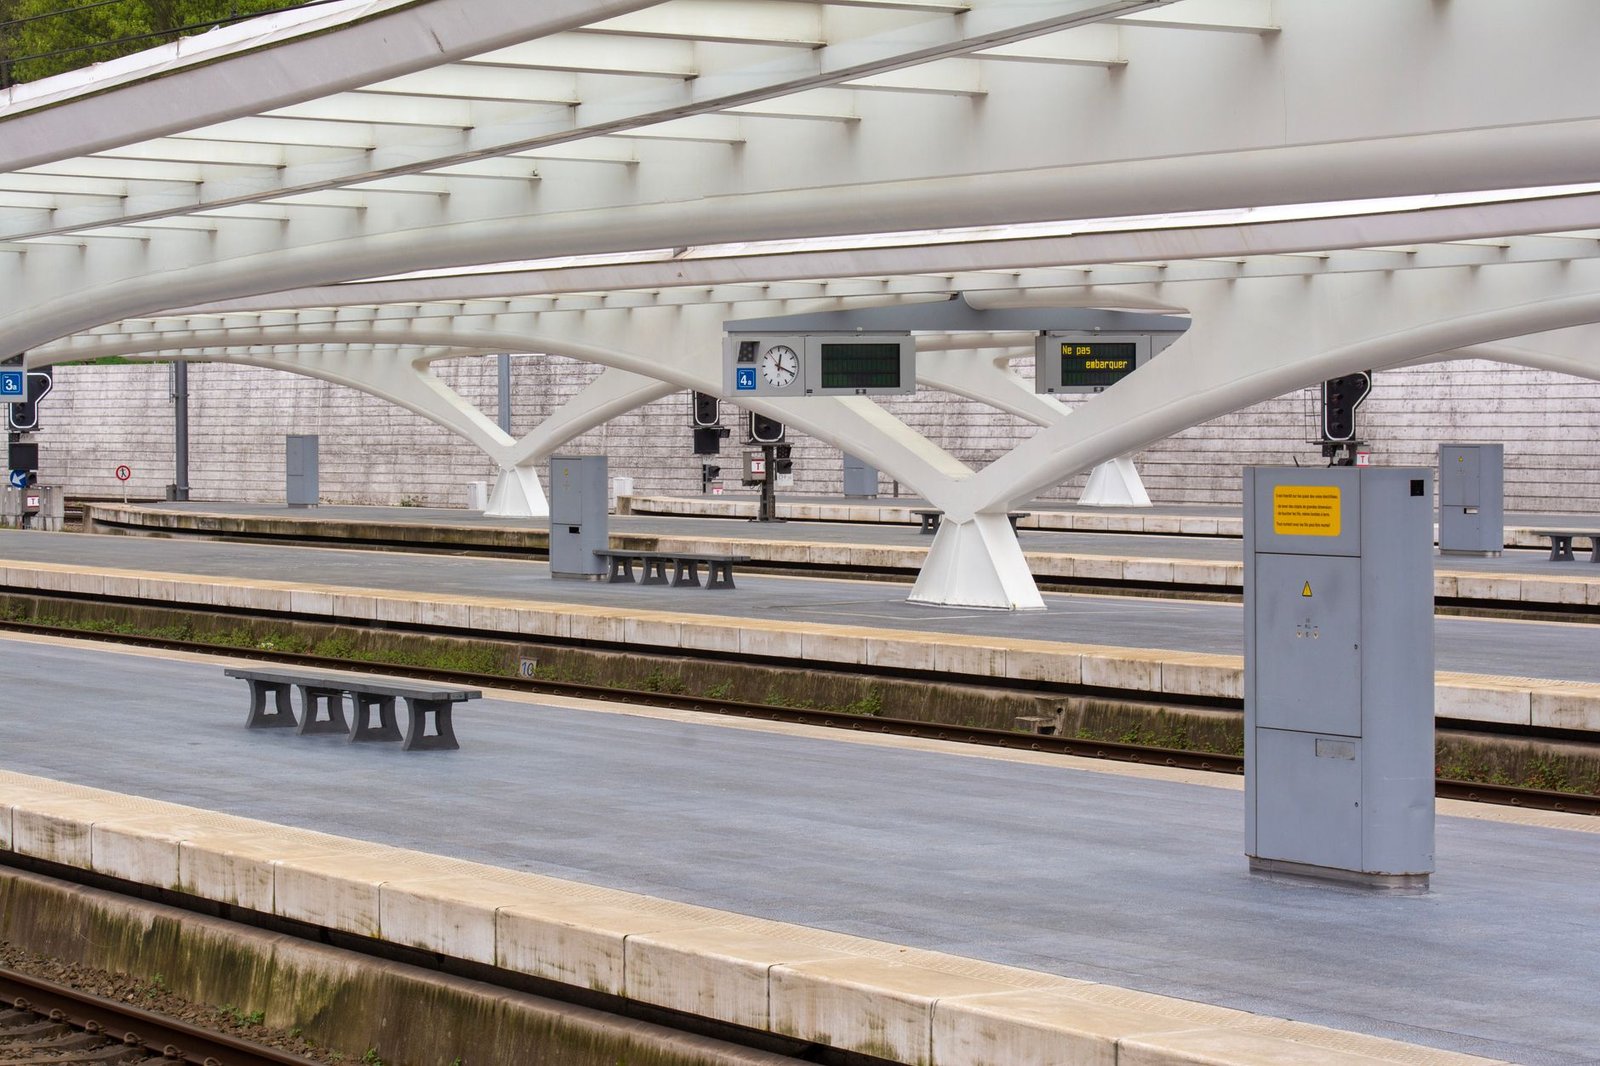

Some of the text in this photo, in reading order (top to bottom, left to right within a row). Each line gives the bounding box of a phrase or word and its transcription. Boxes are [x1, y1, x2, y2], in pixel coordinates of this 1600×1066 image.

[1062, 345, 1091, 356] Ne pas
[1085, 359, 1128, 370] embarquer
[5, 379, 17, 391] 3a
[740, 374, 752, 386] 4a
